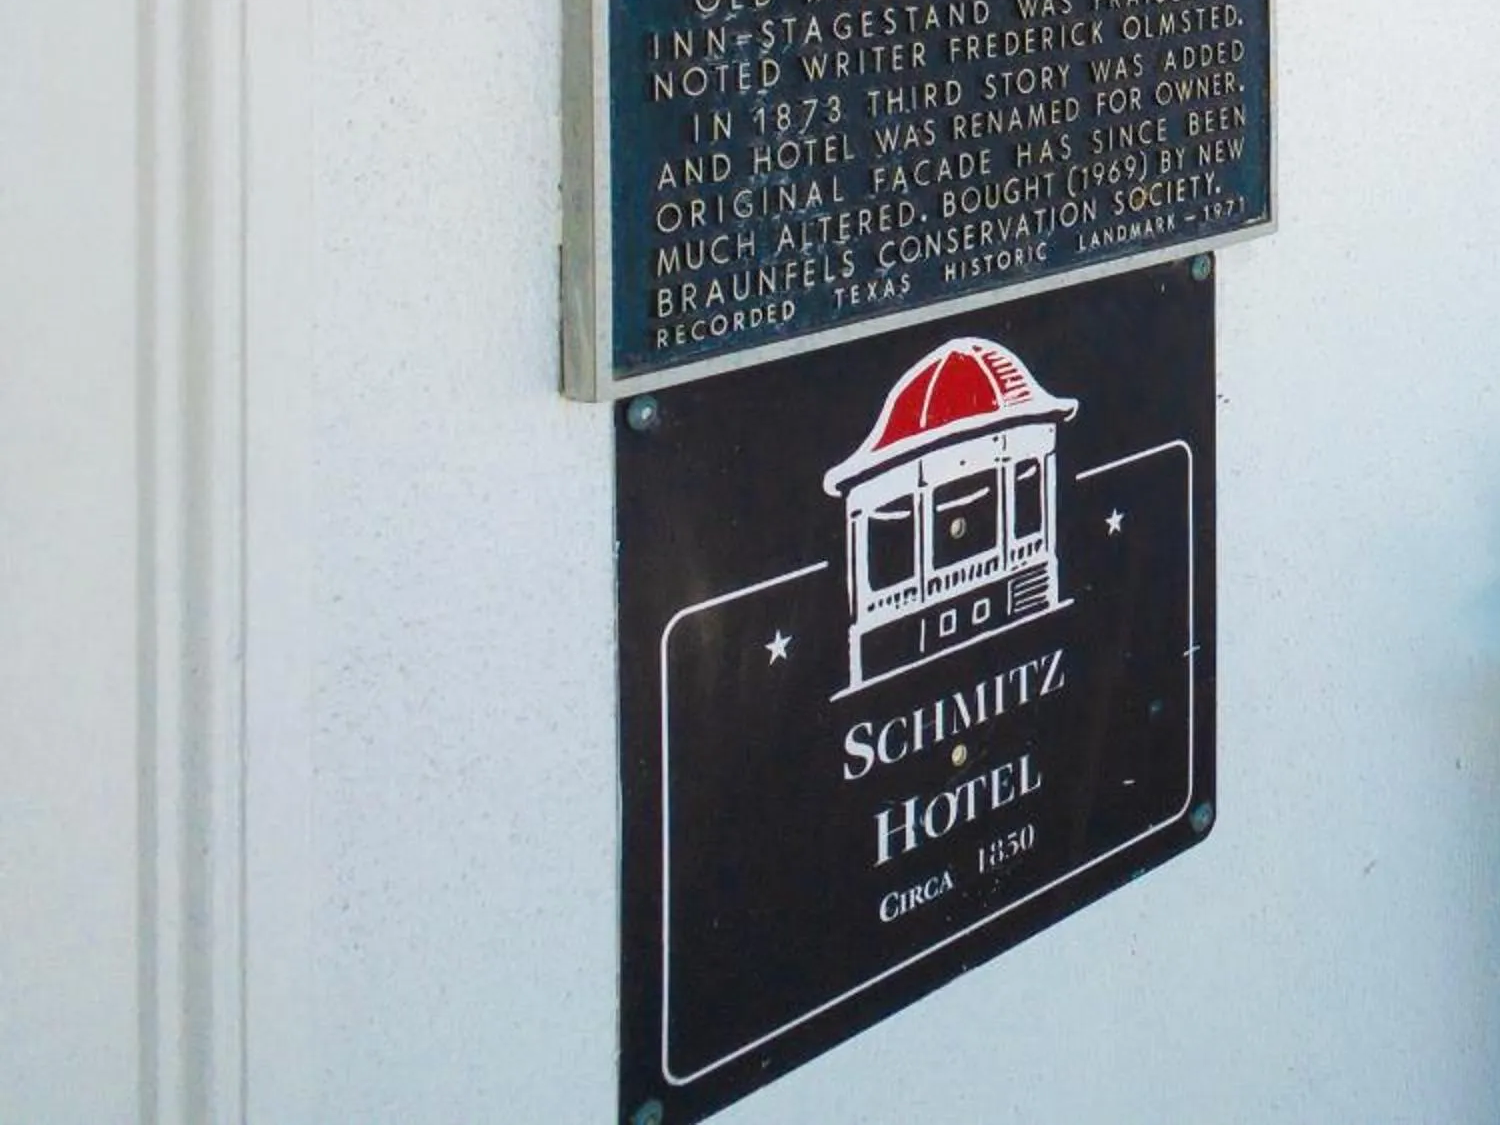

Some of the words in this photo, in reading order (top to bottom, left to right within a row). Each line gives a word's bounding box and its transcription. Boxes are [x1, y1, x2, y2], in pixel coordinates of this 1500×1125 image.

[654, 58, 781, 102] NOTED
[802, 42, 926, 83] WRITER
[950, 21, 1104, 63] FREDERICK
[1123, 5, 1244, 40] OLMSTED.
[693, 112, 731, 143] IN
[753, 95, 842, 136] 1873
[867, 80, 961, 118] THIRD
[985, 64, 1070, 100] STORY
[1092, 53, 1144, 83] WAS
[1164, 39, 1245, 72] ADDED
[656, 178, 845, 234] ORIGINAL
[873, 149, 992, 194] FACADE
[1017, 134, 1072, 168] HAS
[1093, 118, 1168, 154] SINCE
[1189, 105, 1247, 137] BEEN
[657, 153, 731, 191] AND
[753, 134, 855, 175] HOTEL
[875, 119, 936, 154] WAS
[953, 98, 1080, 140] RENAMED
[1096, 88, 1142, 116] FOR
[1155, 72, 1246, 106] OWNER.
[656, 232, 755, 278] MUCH
[777, 202, 928, 250] ALTERED.
[942, 173, 1053, 219] BOUGHT
[1067, 151, 1148, 198] (1969)
[1160, 147, 1186, 174] BY
[1199, 136, 1244, 166] NEW
[656, 250, 856, 319] BRAUNFELS
[878, 199, 1098, 268] CONSERVATION
[1114, 172, 1222, 216] SOCIETY.
[656, 300, 796, 349] RECORDED
[834, 273, 912, 309] TEXAS
[944, 242, 1049, 283] HISTORIC
[1077, 213, 1176, 253] LANDMARK
[842, 648, 1066, 782] SCHMITZ
[873, 754, 1044, 868] HOTEL
[878, 872, 954, 924] CIRCA
[977, 823, 1036, 876] 1850
